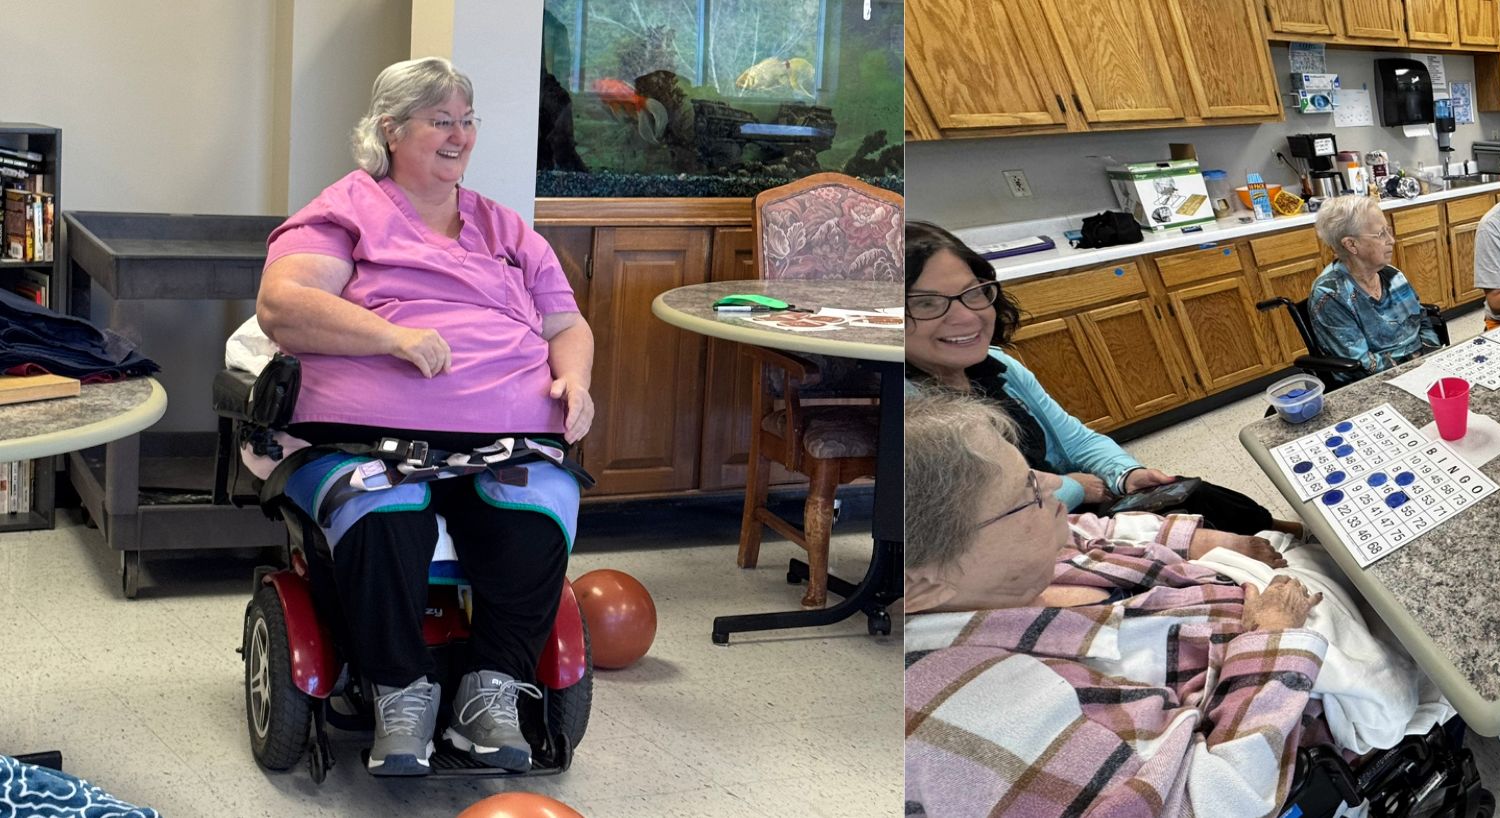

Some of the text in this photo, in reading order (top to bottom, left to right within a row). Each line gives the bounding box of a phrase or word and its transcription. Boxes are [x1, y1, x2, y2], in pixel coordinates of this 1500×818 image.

[1374, 456, 1384, 464] 73
[1390, 448, 1402, 456] 71
[1352, 464, 1364, 473] 67
[1410, 455, 1467, 506] 10 19 45 58 73
[1310, 483, 1324, 492] 63
[1412, 486, 1424, 495] 43
[1422, 494, 1436, 506] 53
[1434, 506, 1448, 517] 71
[1359, 494, 1374, 505] 25
[1370, 506, 1384, 517] 41
[1380, 518, 1394, 529] 47
[1390, 529, 1406, 542] 75
[1381, 484, 1428, 530] 16 55 72
[1337, 505, 1382, 554] 22 33 46 68
